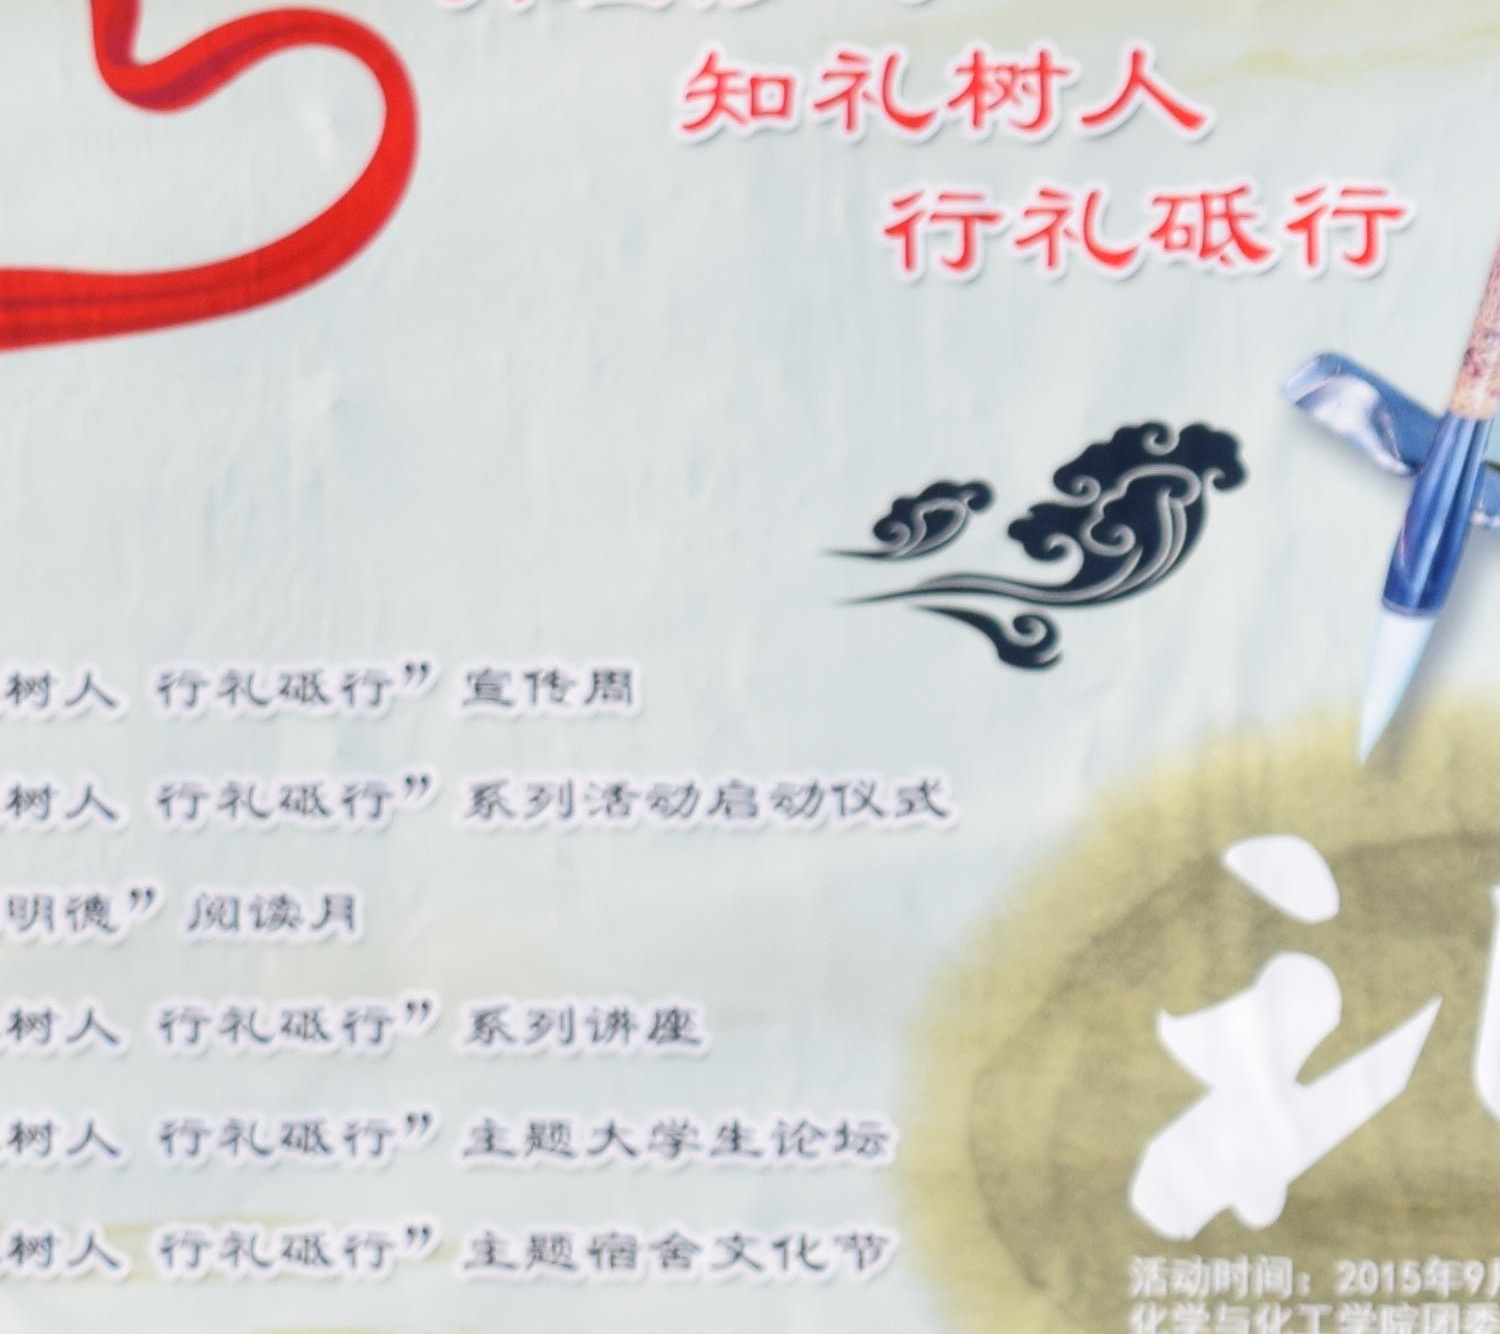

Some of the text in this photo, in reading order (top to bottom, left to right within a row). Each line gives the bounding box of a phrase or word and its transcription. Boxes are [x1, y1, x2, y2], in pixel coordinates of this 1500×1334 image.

[679, 47, 1209, 135] 知礼树人
[883, 185, 1407, 272] 行礼砥行
